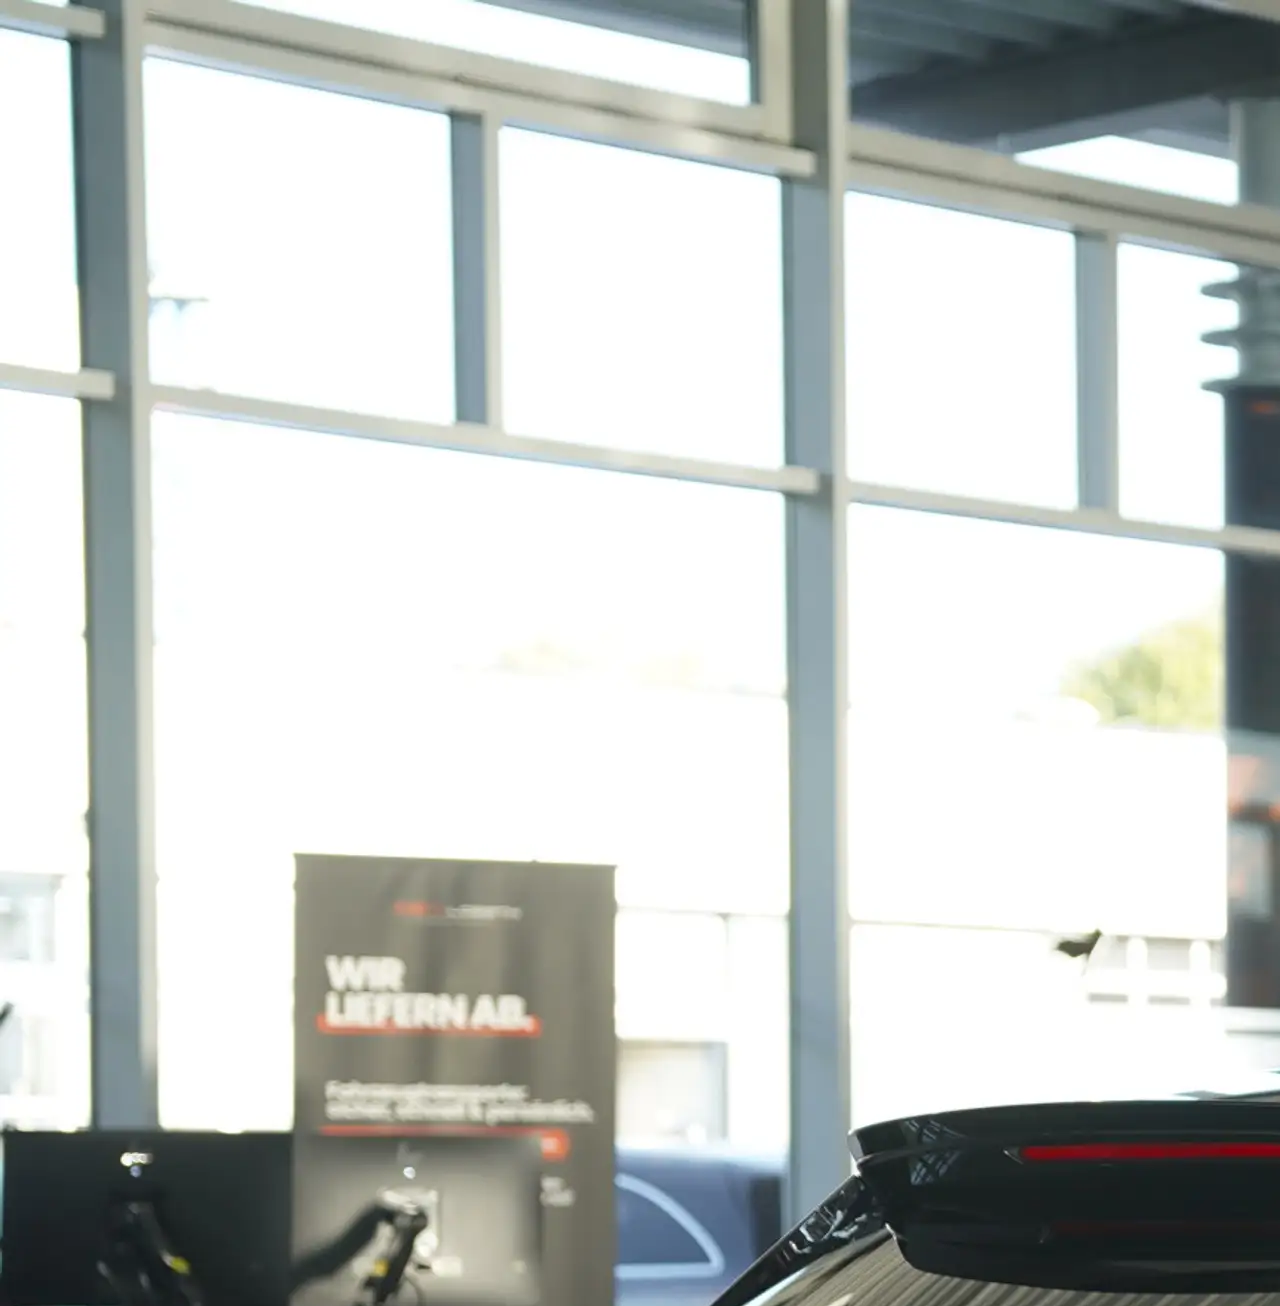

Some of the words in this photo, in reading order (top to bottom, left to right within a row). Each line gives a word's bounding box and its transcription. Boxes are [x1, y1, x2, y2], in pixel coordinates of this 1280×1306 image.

[325, 955, 406, 991] WIR
[325, 990, 469, 1030] LIEFERN
[470, 993, 534, 1032] AB.
